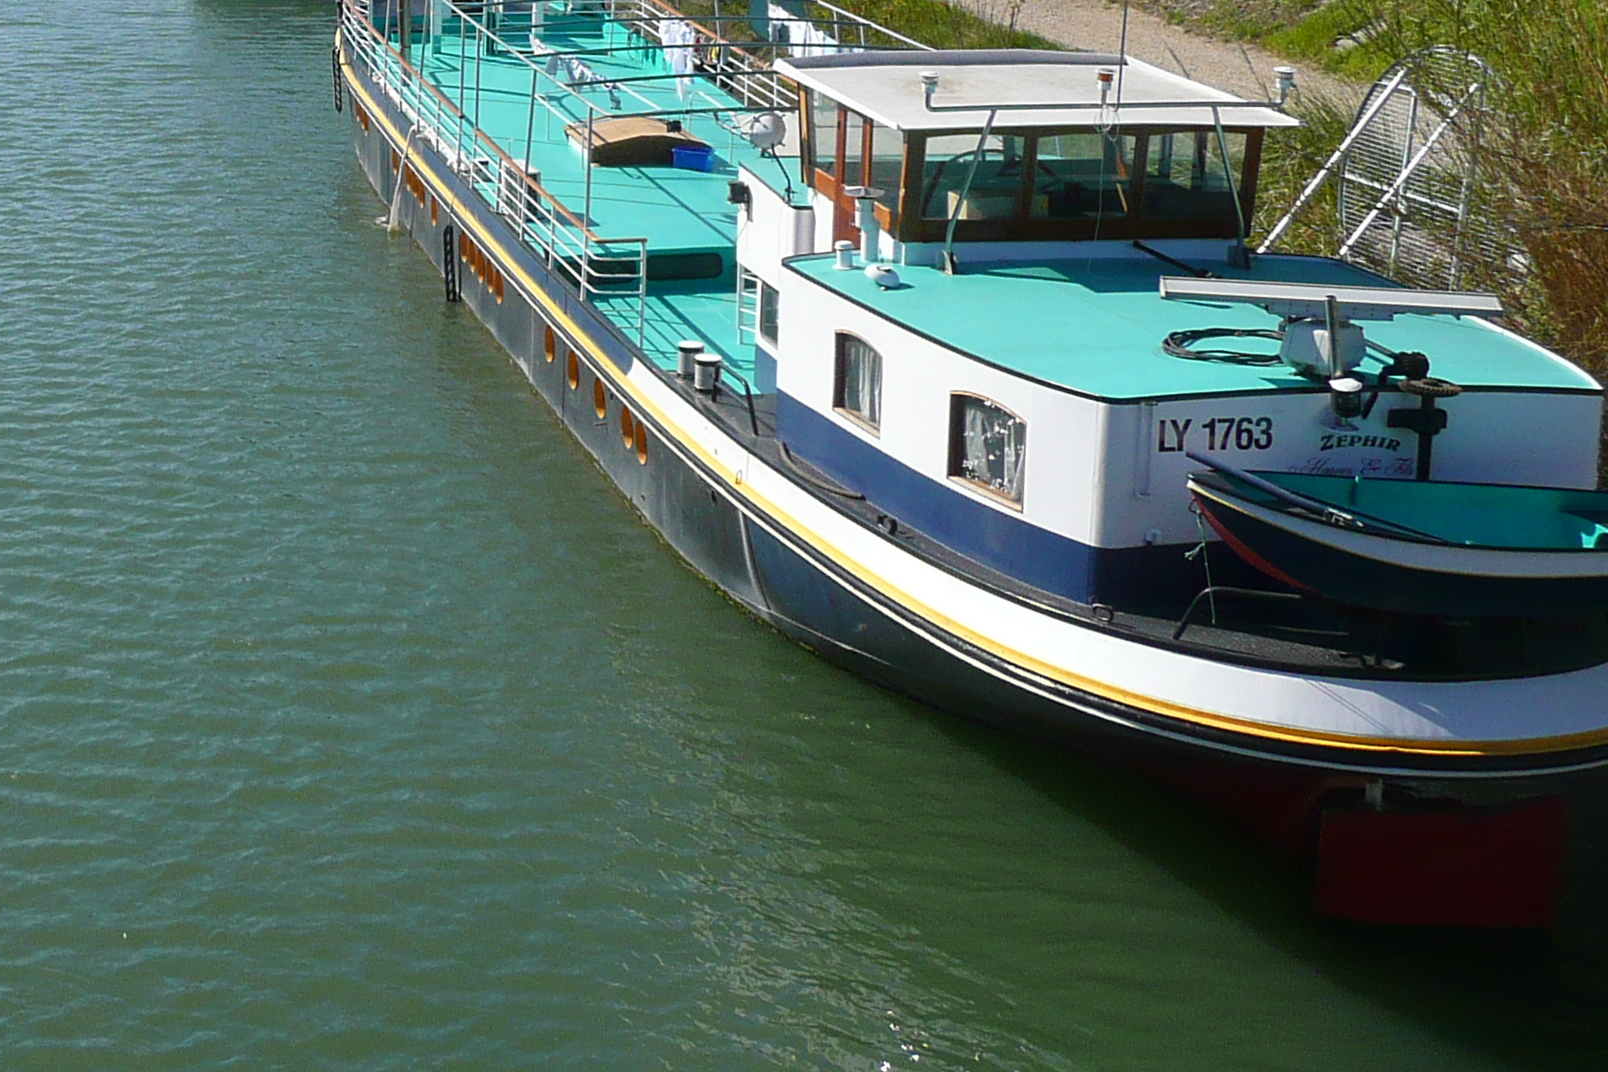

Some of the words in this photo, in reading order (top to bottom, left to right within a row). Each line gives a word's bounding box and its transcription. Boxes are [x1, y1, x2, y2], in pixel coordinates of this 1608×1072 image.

[1158, 419, 1192, 452] LY
[1202, 417, 1273, 450] 1763
[1320, 434, 1401, 451] ZEPHIR
